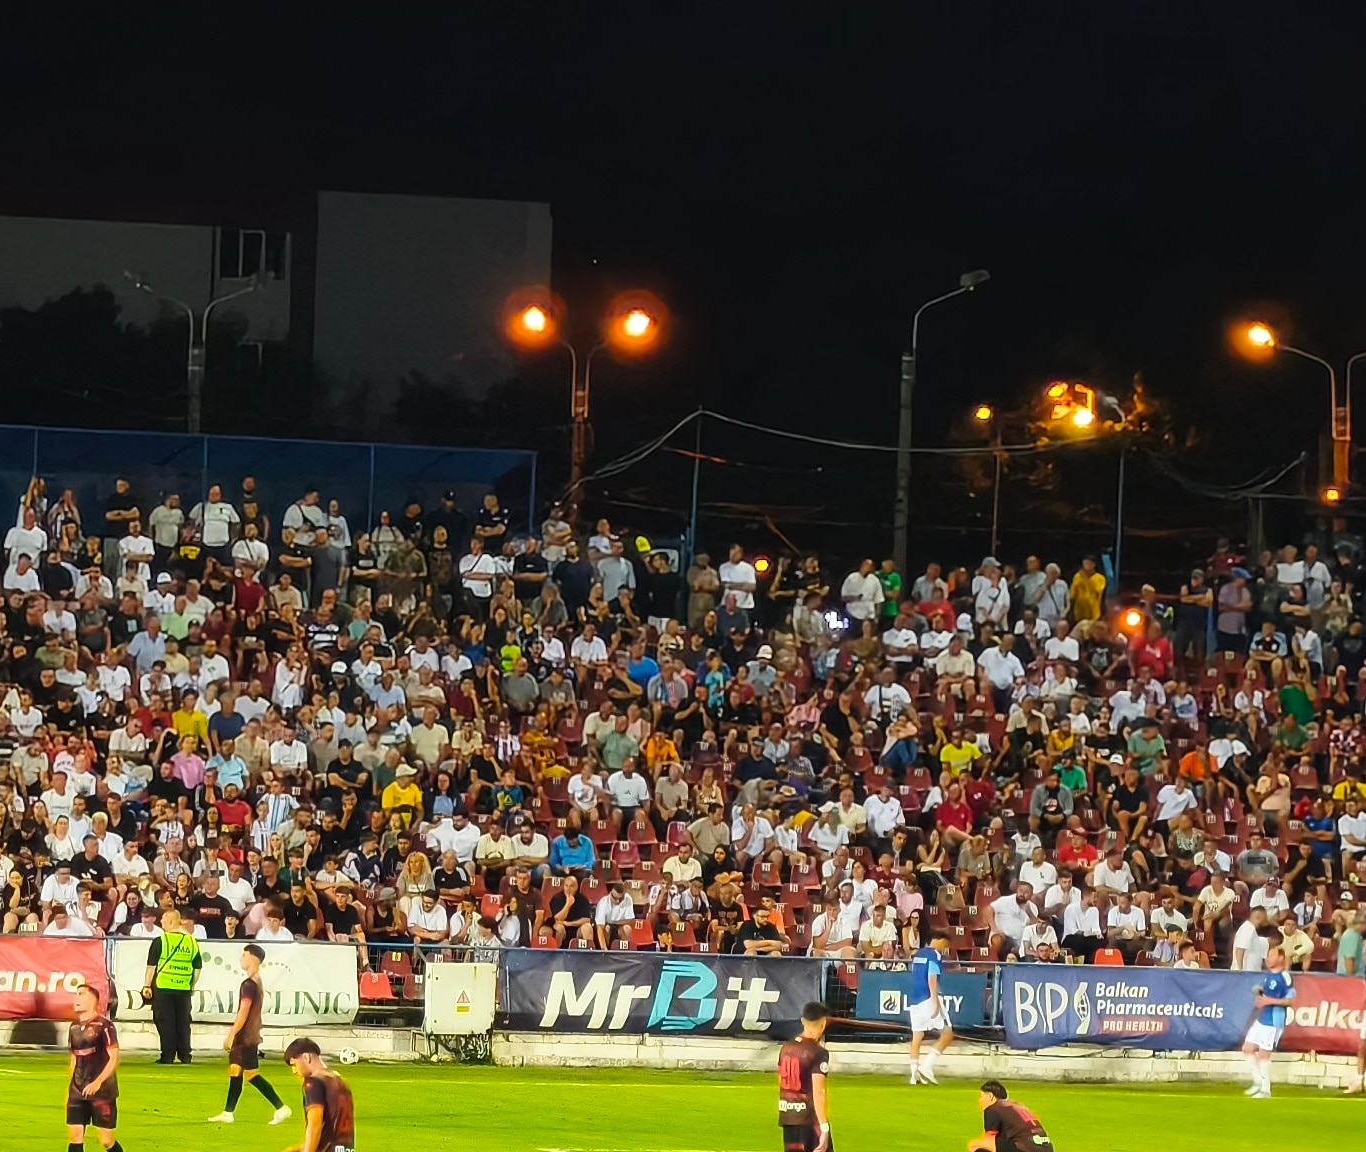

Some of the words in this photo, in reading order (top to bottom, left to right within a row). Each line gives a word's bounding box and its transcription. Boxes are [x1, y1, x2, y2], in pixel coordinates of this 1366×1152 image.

[539, 960, 781, 1031] MrBit
[1096, 981, 1149, 999] Balkan
[1096, 999, 1224, 1020] Pharmaceuticals
[1102, 1019, 1124, 1032] PRO
[1125, 1019, 1164, 1033] HEALTH
